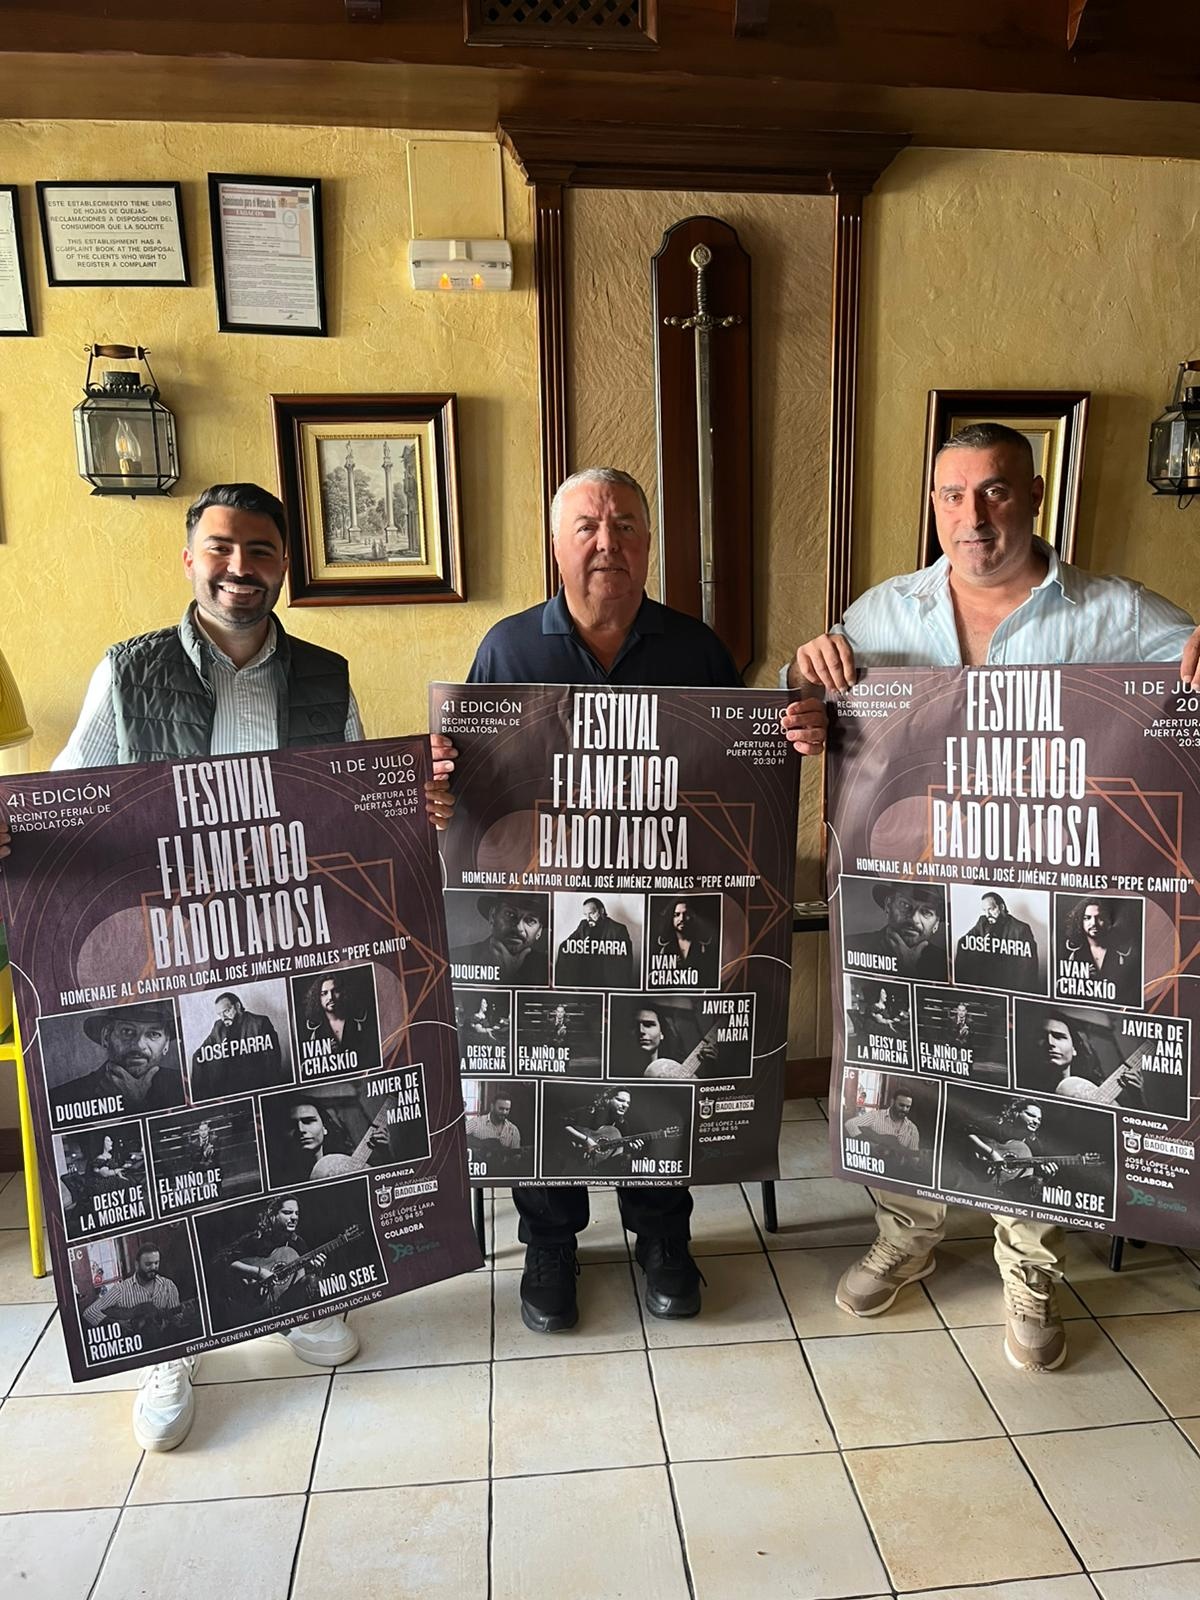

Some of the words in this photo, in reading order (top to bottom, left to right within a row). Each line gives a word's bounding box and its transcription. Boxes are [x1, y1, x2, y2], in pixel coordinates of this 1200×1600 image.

[852, 681, 912, 695] EDICIÓN
[441, 700, 454, 712] 41
[460, 698, 521, 713] EDICIÓN
[968, 669, 1064, 731] FESTIVAL
[573, 692, 659, 750] FESTIVAL
[710, 706, 720, 718] 11
[725, 707, 744, 719] DE
[329, 760, 341, 774] 11
[346, 758, 366, 772] DE
[371, 753, 414, 770] JULIO
[946, 736, 1086, 800] FLAMENCO
[377, 769, 416, 785] 2026
[553, 753, 678, 810] FLAMENCO
[6, 792, 25, 808] 41
[32, 782, 111, 805] EDICIÓN
[171, 755, 280, 828] FESTIVAL
[360, 790, 404, 802] APERTURA
[406, 788, 417, 796] DE
[9, 810, 58, 822] RECINTO
[60, 806, 94, 817] FERIAL
[97, 804, 111, 813] DE
[354, 800, 392, 811] PUERTAS
[403, 797, 418, 805] LAS
[384, 807, 408, 817] 20:30
[410, 806, 416, 814] H
[11, 817, 84, 833] BADOLATOSA
[933, 800, 1101, 867] BADOLATOSA
[539, 814, 688, 870] BADOLATOSA
[157, 819, 309, 900] FLAMENCO
[462, 871, 506, 884] HOMENAJE
[509, 872, 519, 884] AL
[522, 872, 561, 885] CANTAOR
[565, 874, 589, 887] LOCAL
[594, 873, 613, 887] JOSÉ
[616, 873, 651, 888] JIMÉNEZ
[654, 876, 693, 888] MORALES
[856, 857, 899, 872] HOMENAJE
[903, 861, 914, 874] AL
[916, 862, 958, 877] CANTAOR
[961, 866, 989, 880] LOCAL
[992, 865, 1014, 882] JOSÉ
[1017, 867, 1057, 886] JIMÉNEZ
[1061, 872, 1107, 889] MORALES
[149, 883, 331, 971] BADOLATOSA
[562, 936, 589, 954] JOSÉ
[591, 940, 627, 955] PARRA
[961, 931, 990, 952] JOSÉ
[992, 938, 1031, 957] PARRA
[651, 954, 676, 969] IVAN
[847, 950, 897, 971] DUQUENDE
[1059, 959, 1089, 979] IVAN
[60, 983, 117, 1006] HOMENAJE
[120, 981, 135, 997] AL
[137, 972, 187, 995] CANTAOR
[189, 967, 223, 986] LOCAL
[224, 960, 248, 980] JOSÉ
[250, 954, 292, 977] JIMÉNEZ
[294, 949, 340, 969] MORALES
[651, 967, 698, 985] CHASKÍO
[1059, 975, 1115, 1000] CHASKÍO
[702, 1000, 734, 1014] JAVIER
[738, 999, 750, 1013] DE
[728, 1014, 749, 1027] ANA
[1122, 1019, 1163, 1039] JAVIER
[1167, 1024, 1183, 1042] DE
[717, 1027, 748, 1042] MARIA
[195, 1037, 229, 1063] JOSÉ
[230, 1033, 273, 1056] PARRA
[302, 1037, 332, 1059] IVAN
[1156, 1040, 1183, 1059] ANA
[304, 1048, 358, 1077] CHASKÍO
[1141, 1055, 1183, 1076] MARIA
[366, 1075, 402, 1097] JAVIER
[405, 1072, 418, 1089] DE
[396, 1087, 419, 1106] ANA
[55, 1093, 124, 1123] DUQUENDE
[386, 1103, 421, 1125] MARIA
[1122, 1116, 1168, 1130] ORGANIZA
[845, 1137, 869, 1156] JULIO
[631, 1157, 655, 1173] NIÑO
[658, 1160, 682, 1173] SEBE
[846, 1152, 884, 1174] ROMERO
[158, 1177, 172, 1194] EL
[174, 1168, 204, 1191] NIÑO
[207, 1167, 222, 1184] DE
[374, 1166, 414, 1182] ORGANIZA
[1126, 1173, 1173, 1189] COLABORA
[92, 1188, 126, 1212] DEISY
[129, 1184, 144, 1202] DE
[395, 1179, 437, 1198] BADOLATOSA
[1042, 1183, 1071, 1207] NIÑO
[1075, 1191, 1105, 1213] SEBE
[80, 1213, 95, 1231] LA
[98, 1201, 146, 1226] MORENA
[418, 1201, 434, 1210] LARA
[384, 1222, 424, 1239] COLABORA
[317, 1270, 347, 1297] NIÑO
[349, 1263, 377, 1287] SEBE
[87, 1322, 121, 1345] JULIO
[186, 1338, 219, 1353] ENTRADA
[220, 1329, 251, 1344] GENERAL
[253, 1316, 295, 1334] ANTICIPADA
[318, 1301, 348, 1315] ENTRADA
[349, 1294, 370, 1306] LOCAL
[90, 1332, 143, 1363] ROMERO
